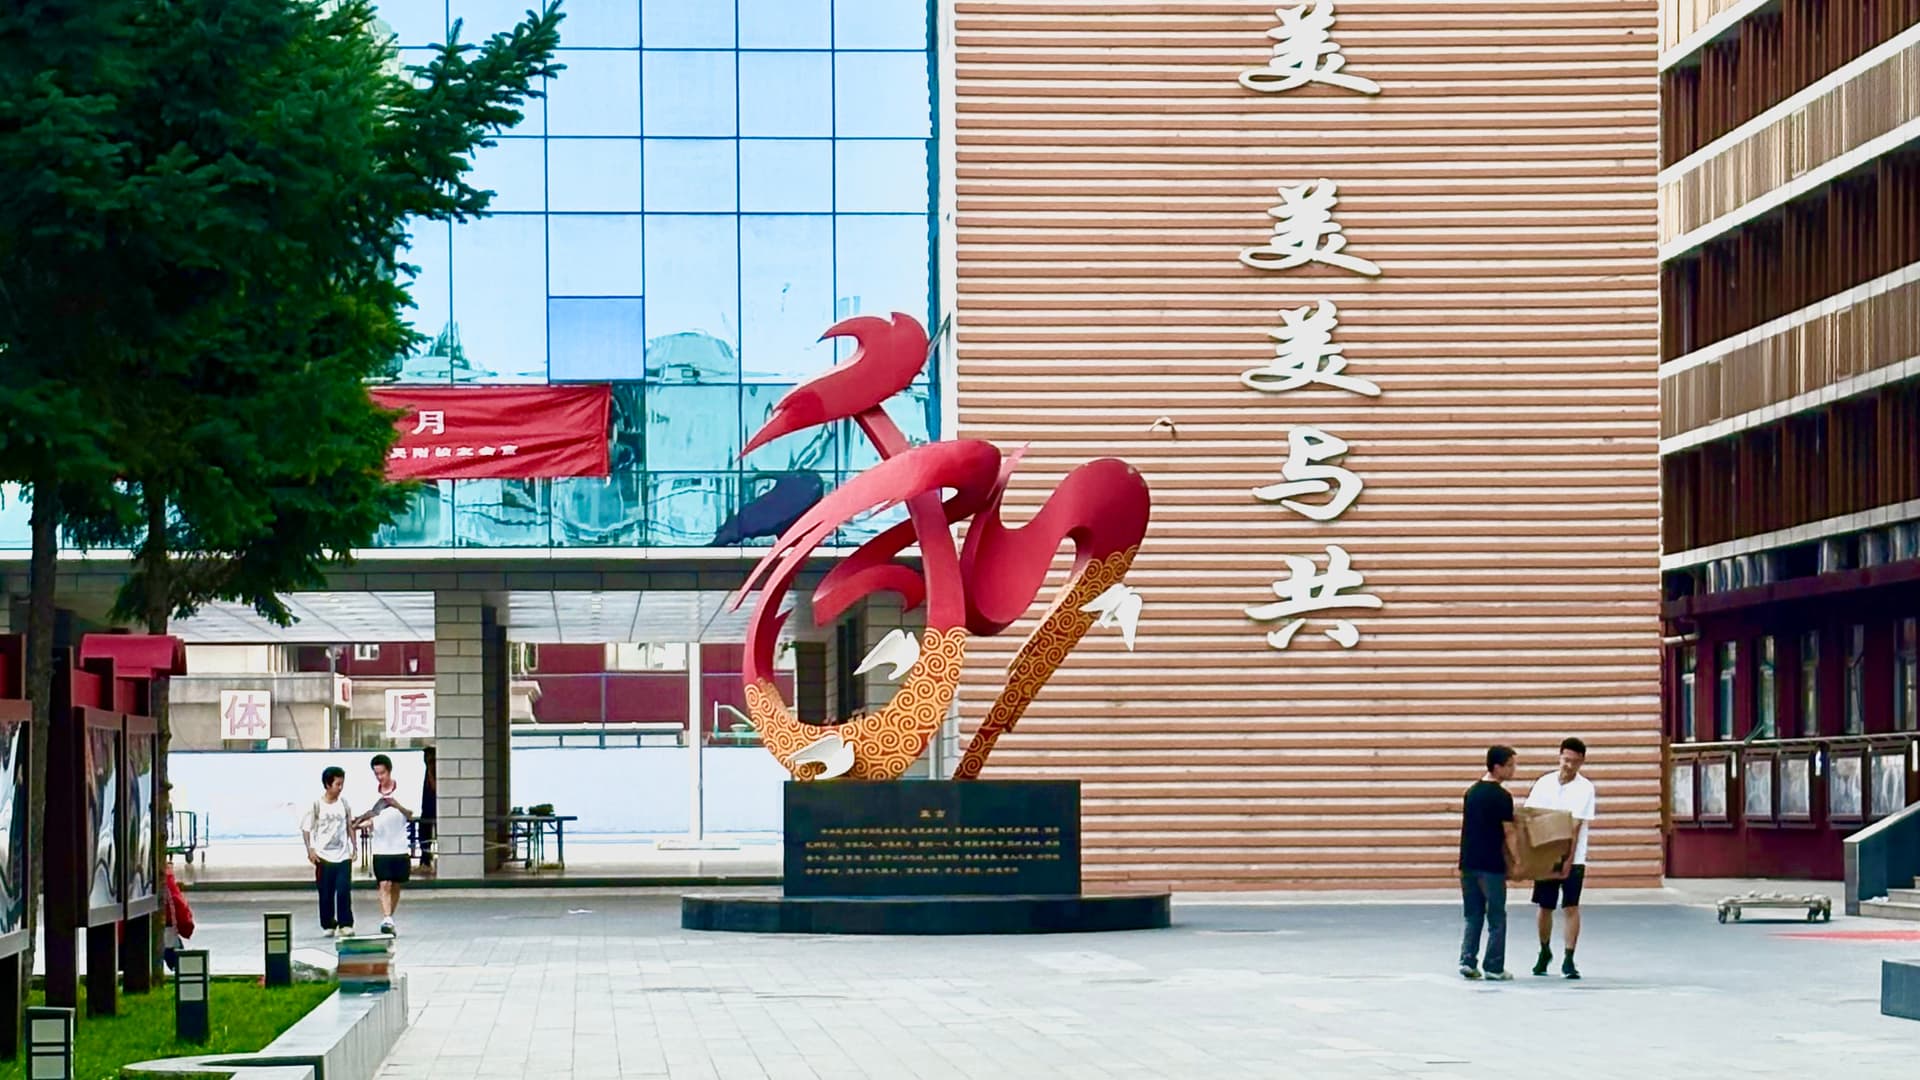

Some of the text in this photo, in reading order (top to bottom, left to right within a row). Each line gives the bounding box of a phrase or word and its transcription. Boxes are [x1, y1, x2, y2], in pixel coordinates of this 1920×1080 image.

[411, 410, 445, 436] 月
[224, 692, 432, 737] 体 质
